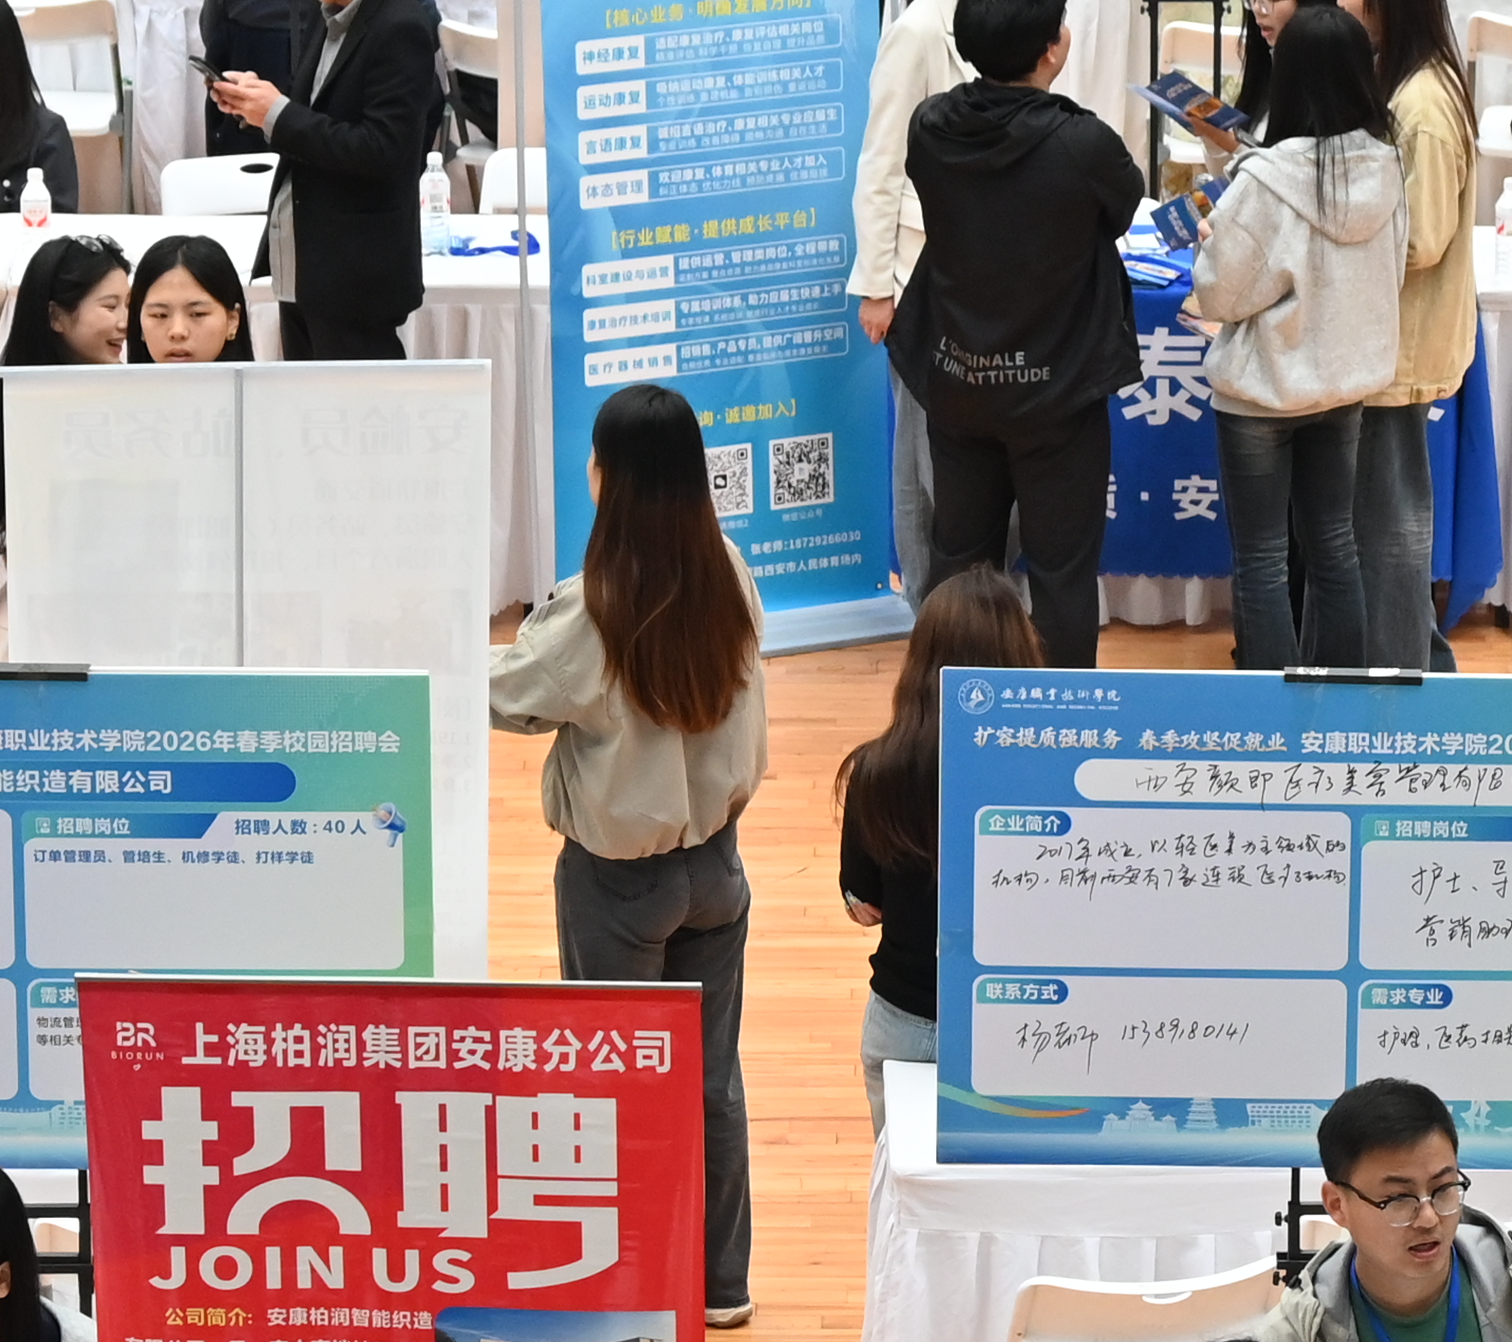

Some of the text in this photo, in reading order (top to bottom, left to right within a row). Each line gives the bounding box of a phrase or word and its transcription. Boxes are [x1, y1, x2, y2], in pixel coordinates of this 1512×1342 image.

[582, 45, 641, 64] 神经康复
[583, 90, 642, 110] 运动康复
[584, 135, 643, 154] 言语康复
[585, 179, 644, 199] 体态管理
[965, 366, 1051, 385] ATTITUDE
[1116, 326, 1214, 426] 泰
[1172, 474, 1219, 521] 安
[972, 726, 1123, 751] 扩容提质强服务
[55, 816, 131, 837] 招聘岗位
[988, 814, 1062, 835] 企业简介
[1394, 818, 1469, 840] 招聘岗位
[33, 849, 315, 866] 订单管理员、管培生、机修学徒、打样学徒
[985, 982, 1060, 1003] 联系方式
[1370, 986, 1446, 1008] 需求专业
[110, 1051, 165, 1062] BIORUN
[181, 1022, 673, 1075] 上海柏润集团安康分公司
[141, 1085, 620, 1291] 招聘
[147, 1245, 476, 1294] JOIN US
